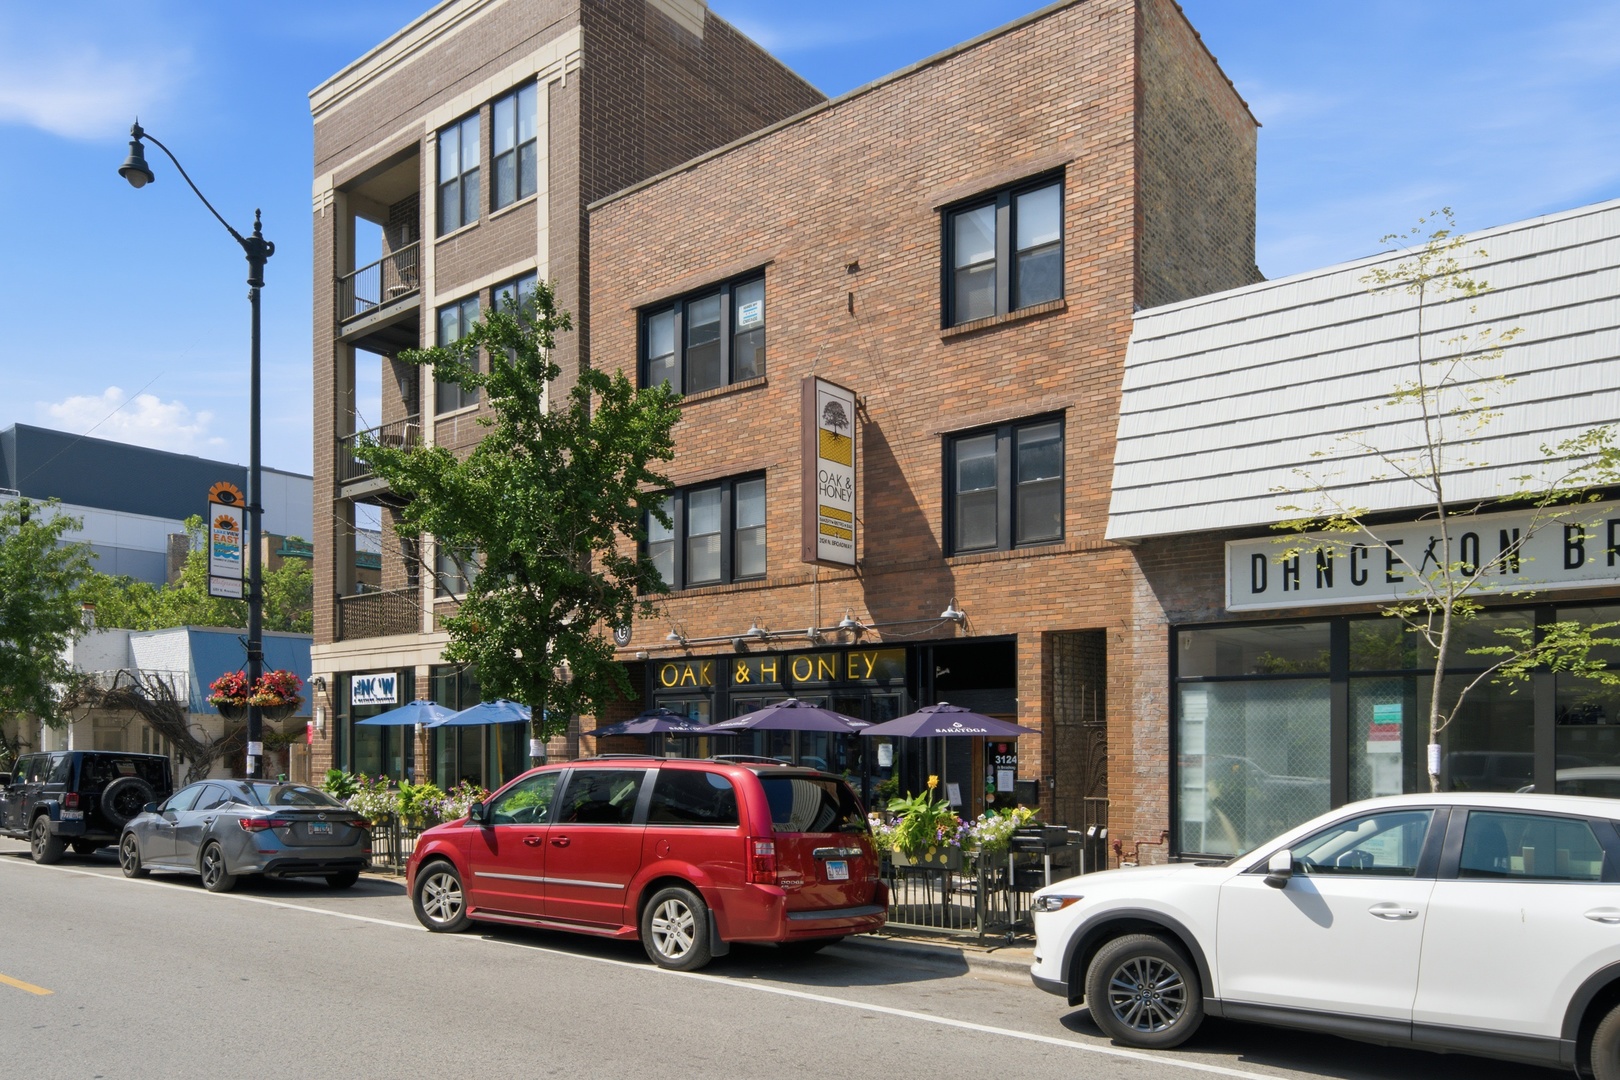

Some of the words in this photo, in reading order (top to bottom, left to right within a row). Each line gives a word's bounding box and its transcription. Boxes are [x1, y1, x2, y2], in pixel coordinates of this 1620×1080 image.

[819, 470, 842, 487] OAK
[845, 477, 852, 490] &
[819, 483, 852, 502] HONEY
[213, 534, 239, 544] EAST
[1461, 528, 1519, 577] ON
[661, 661, 712, 687] OAK
[735, 660, 750, 683] &
[760, 652, 878, 683] HONEY
[995, 755, 1017, 764] 3124
